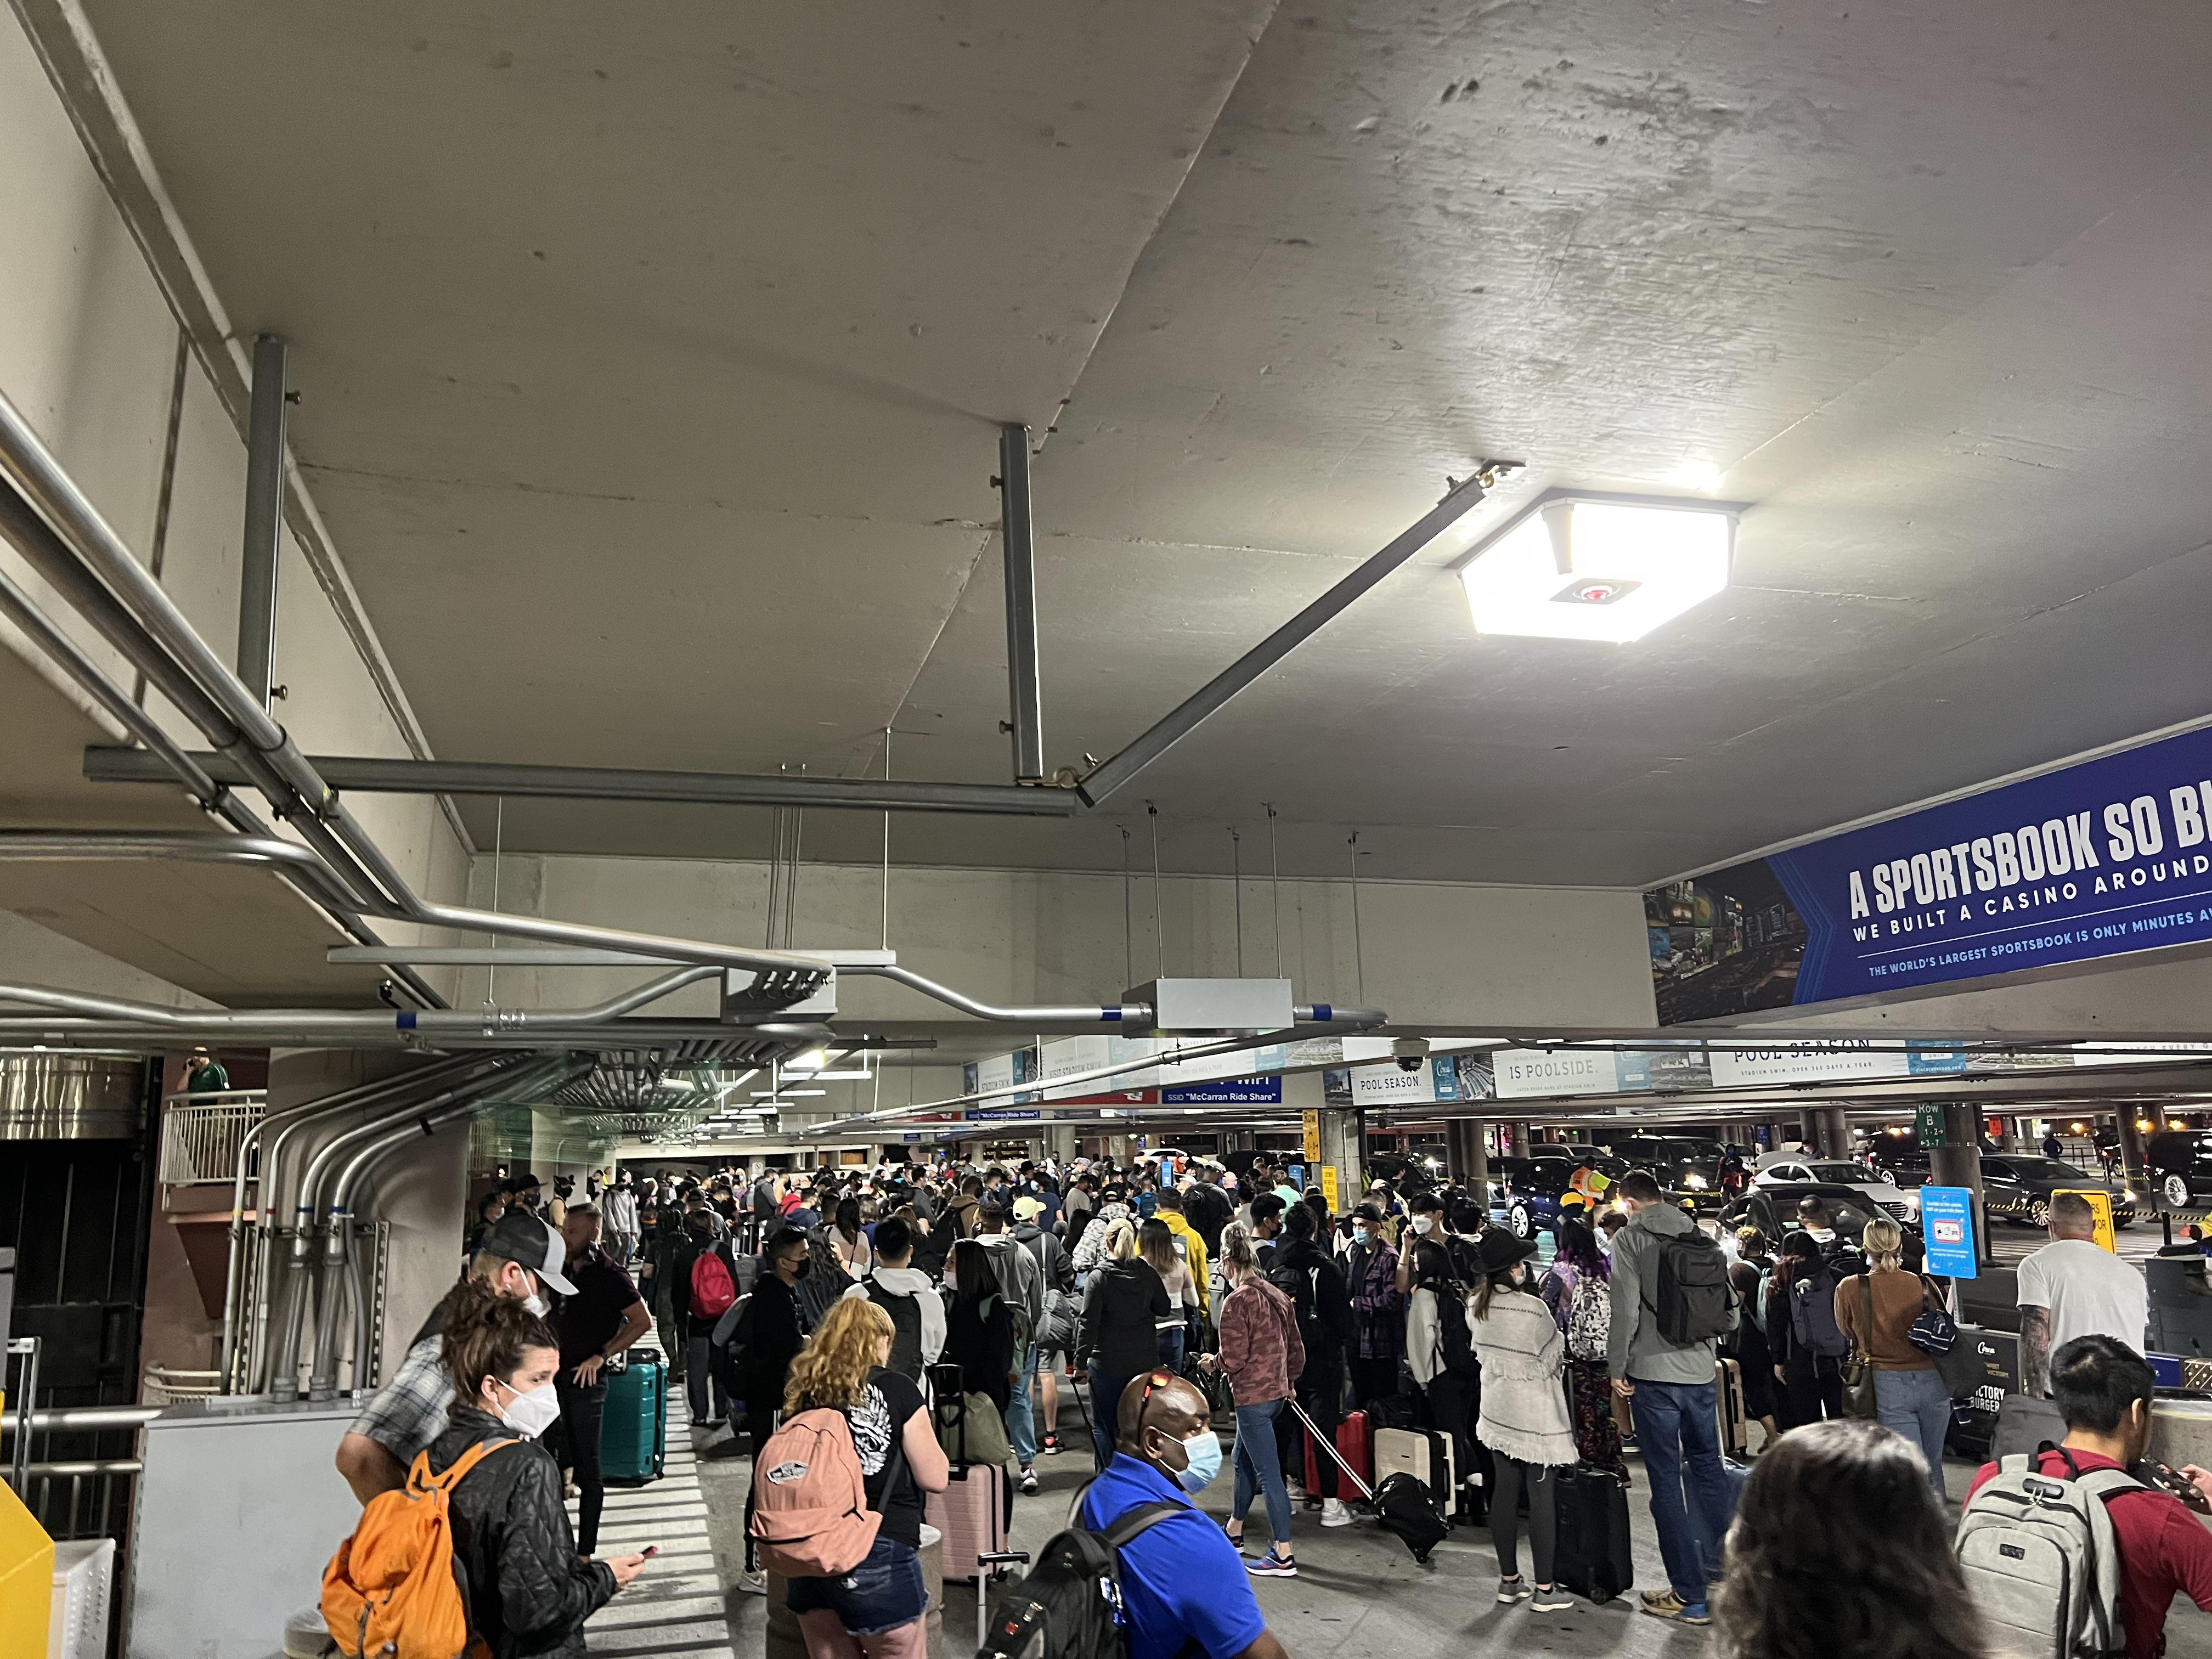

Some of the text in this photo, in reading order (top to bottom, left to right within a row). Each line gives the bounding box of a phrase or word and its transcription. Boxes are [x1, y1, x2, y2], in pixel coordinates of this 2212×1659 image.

[1849, 780, 2212, 919] A SPORTSBOOK SO BI
[1853, 855, 2209, 941] WE BUILT A CASINO AROUND
[1869, 965, 1887, 977] THE
[1889, 957, 1936, 974] WORLD'S
[1939, 947, 1987, 966] LARGEST
[1991, 932, 2073, 957] SPORTSBOOK
[2076, 929, 2089, 943] IS
[2093, 923, 2126, 939] ONLY
[2132, 911, 2194, 933] MINUTES
[1361, 1076, 1422, 1091] POOL SEASON.
[1509, 1059, 1599, 1079] IS POOLSIDE.
[1926, 1115, 1933, 1126] B
